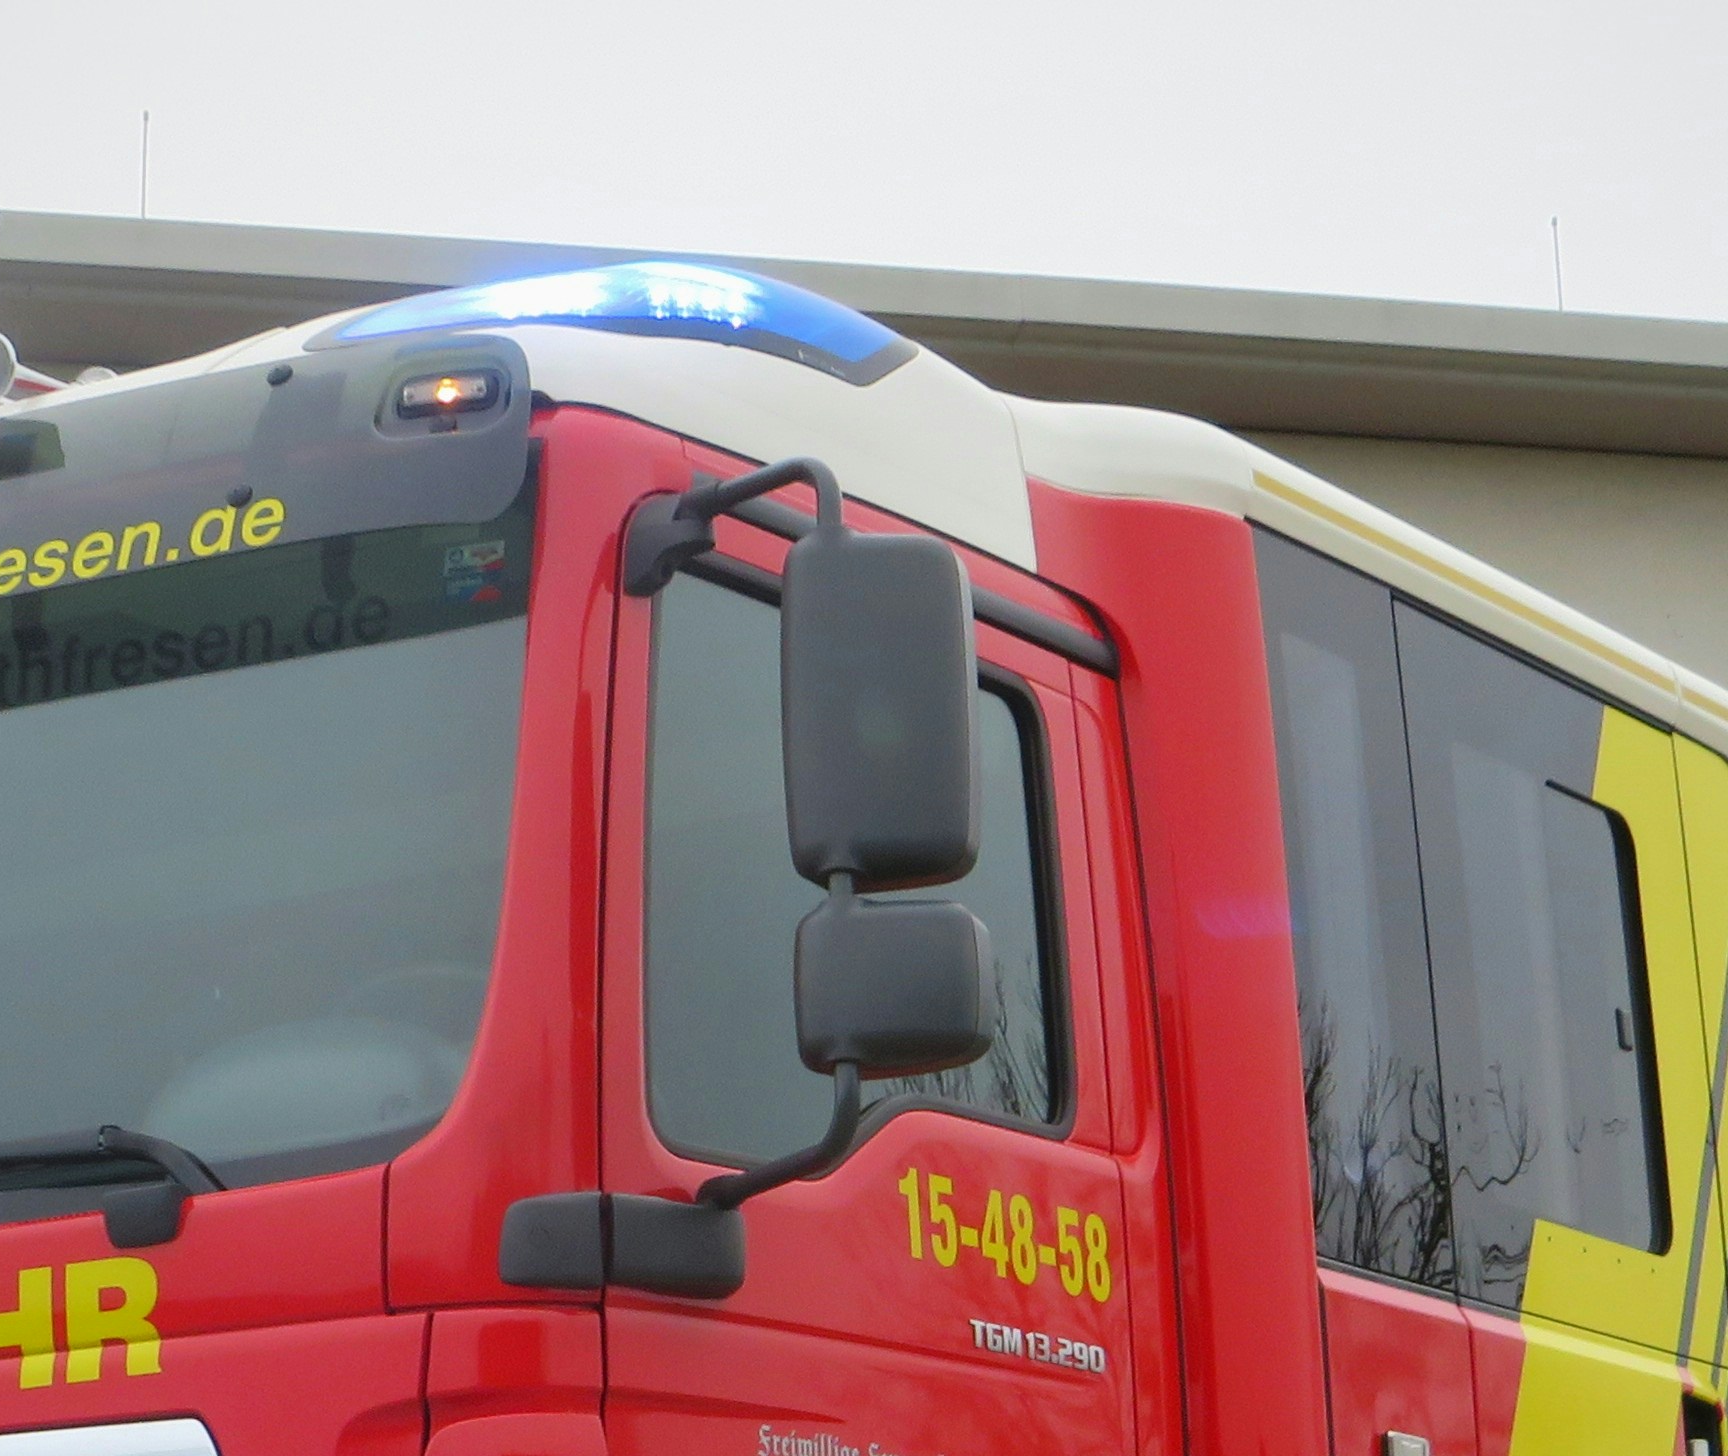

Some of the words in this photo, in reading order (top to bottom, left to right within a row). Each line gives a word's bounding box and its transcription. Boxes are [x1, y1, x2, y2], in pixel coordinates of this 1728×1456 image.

[898, 1167, 1111, 1303] 15-48-58
[970, 1318, 1022, 1357] TGM
[1025, 1332, 1106, 1374] 13.290
